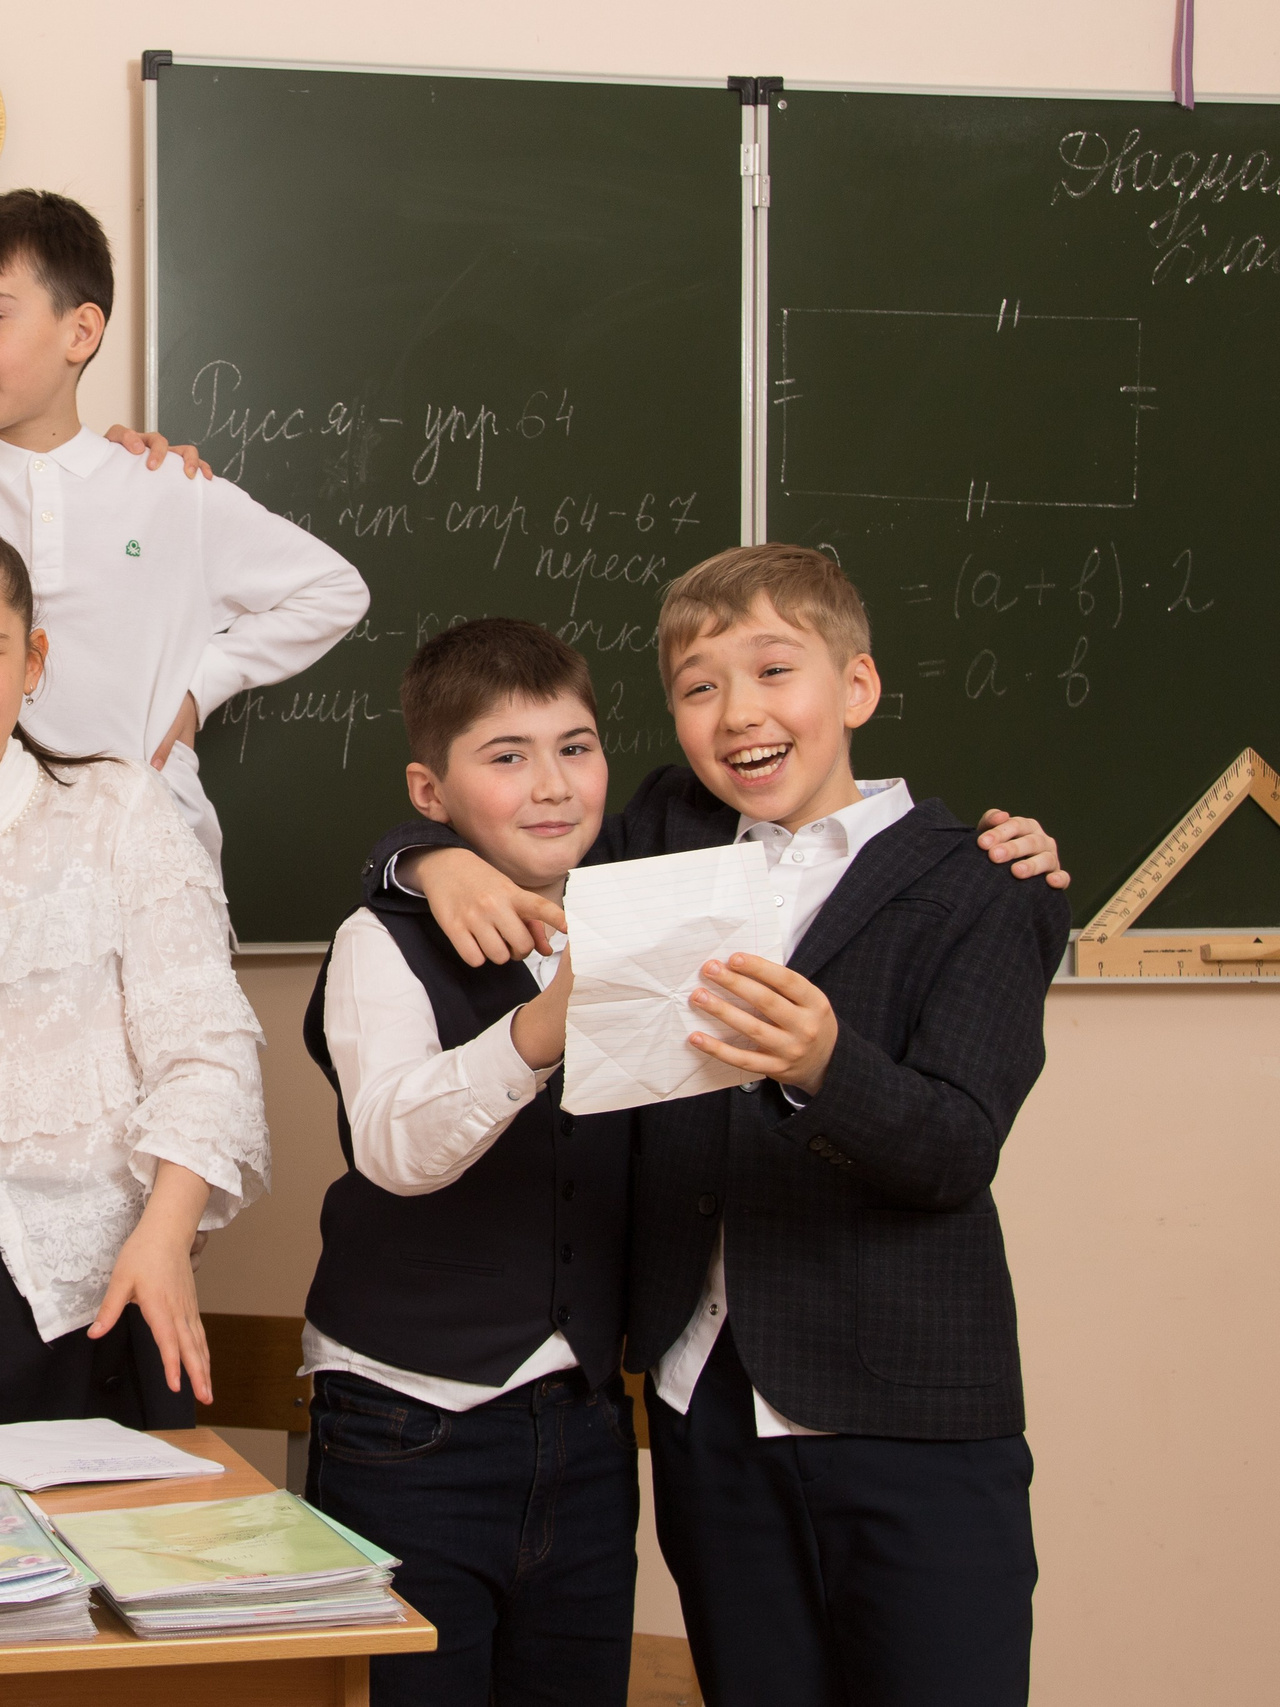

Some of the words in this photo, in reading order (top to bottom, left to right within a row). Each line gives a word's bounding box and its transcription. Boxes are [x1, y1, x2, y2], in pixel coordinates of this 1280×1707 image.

[1051, 128, 1280, 248] Двадца
[517, 388, 574, 438] 64
[1246, 768, 1256, 778] 90
[1223, 790, 1235, 802] 100
[1270, 791, 1280, 802] 80
[1206, 810, 1217, 822] 110
[1191, 826, 1203, 838] 120
[1178, 841, 1189, 853] 130
[1164, 856, 1176, 868] 140
[1151, 871, 1163, 883] 150
[1136, 888, 1148, 900] 160
[1119, 907, 1131, 920] 170
